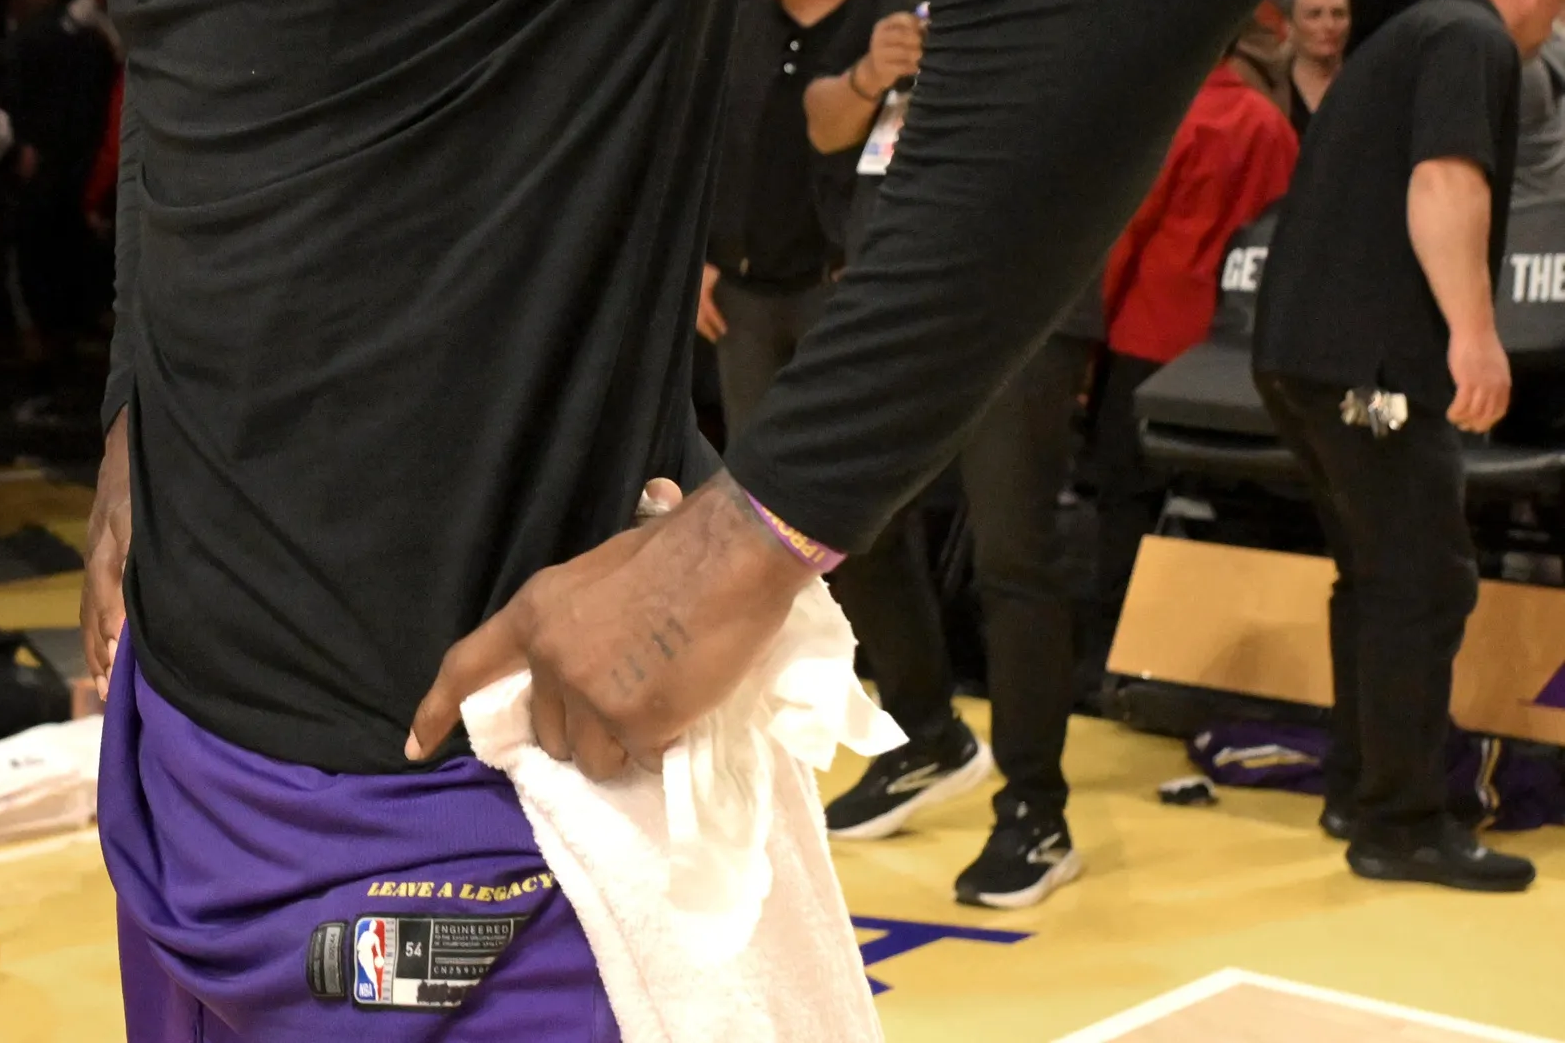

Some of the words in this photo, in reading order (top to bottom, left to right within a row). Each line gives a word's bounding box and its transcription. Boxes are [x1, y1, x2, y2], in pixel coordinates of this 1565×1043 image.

[1220, 246, 1270, 292] GE
[1509, 252, 1565, 303] THE
[366, 881, 435, 898] LEAVE
[437, 881, 453, 898] A
[458, 871, 555, 902] LEGACY
[434, 923, 510, 936] ENGINEERED
[404, 941, 423, 958] 54
[357, 982, 374, 998] NBA
